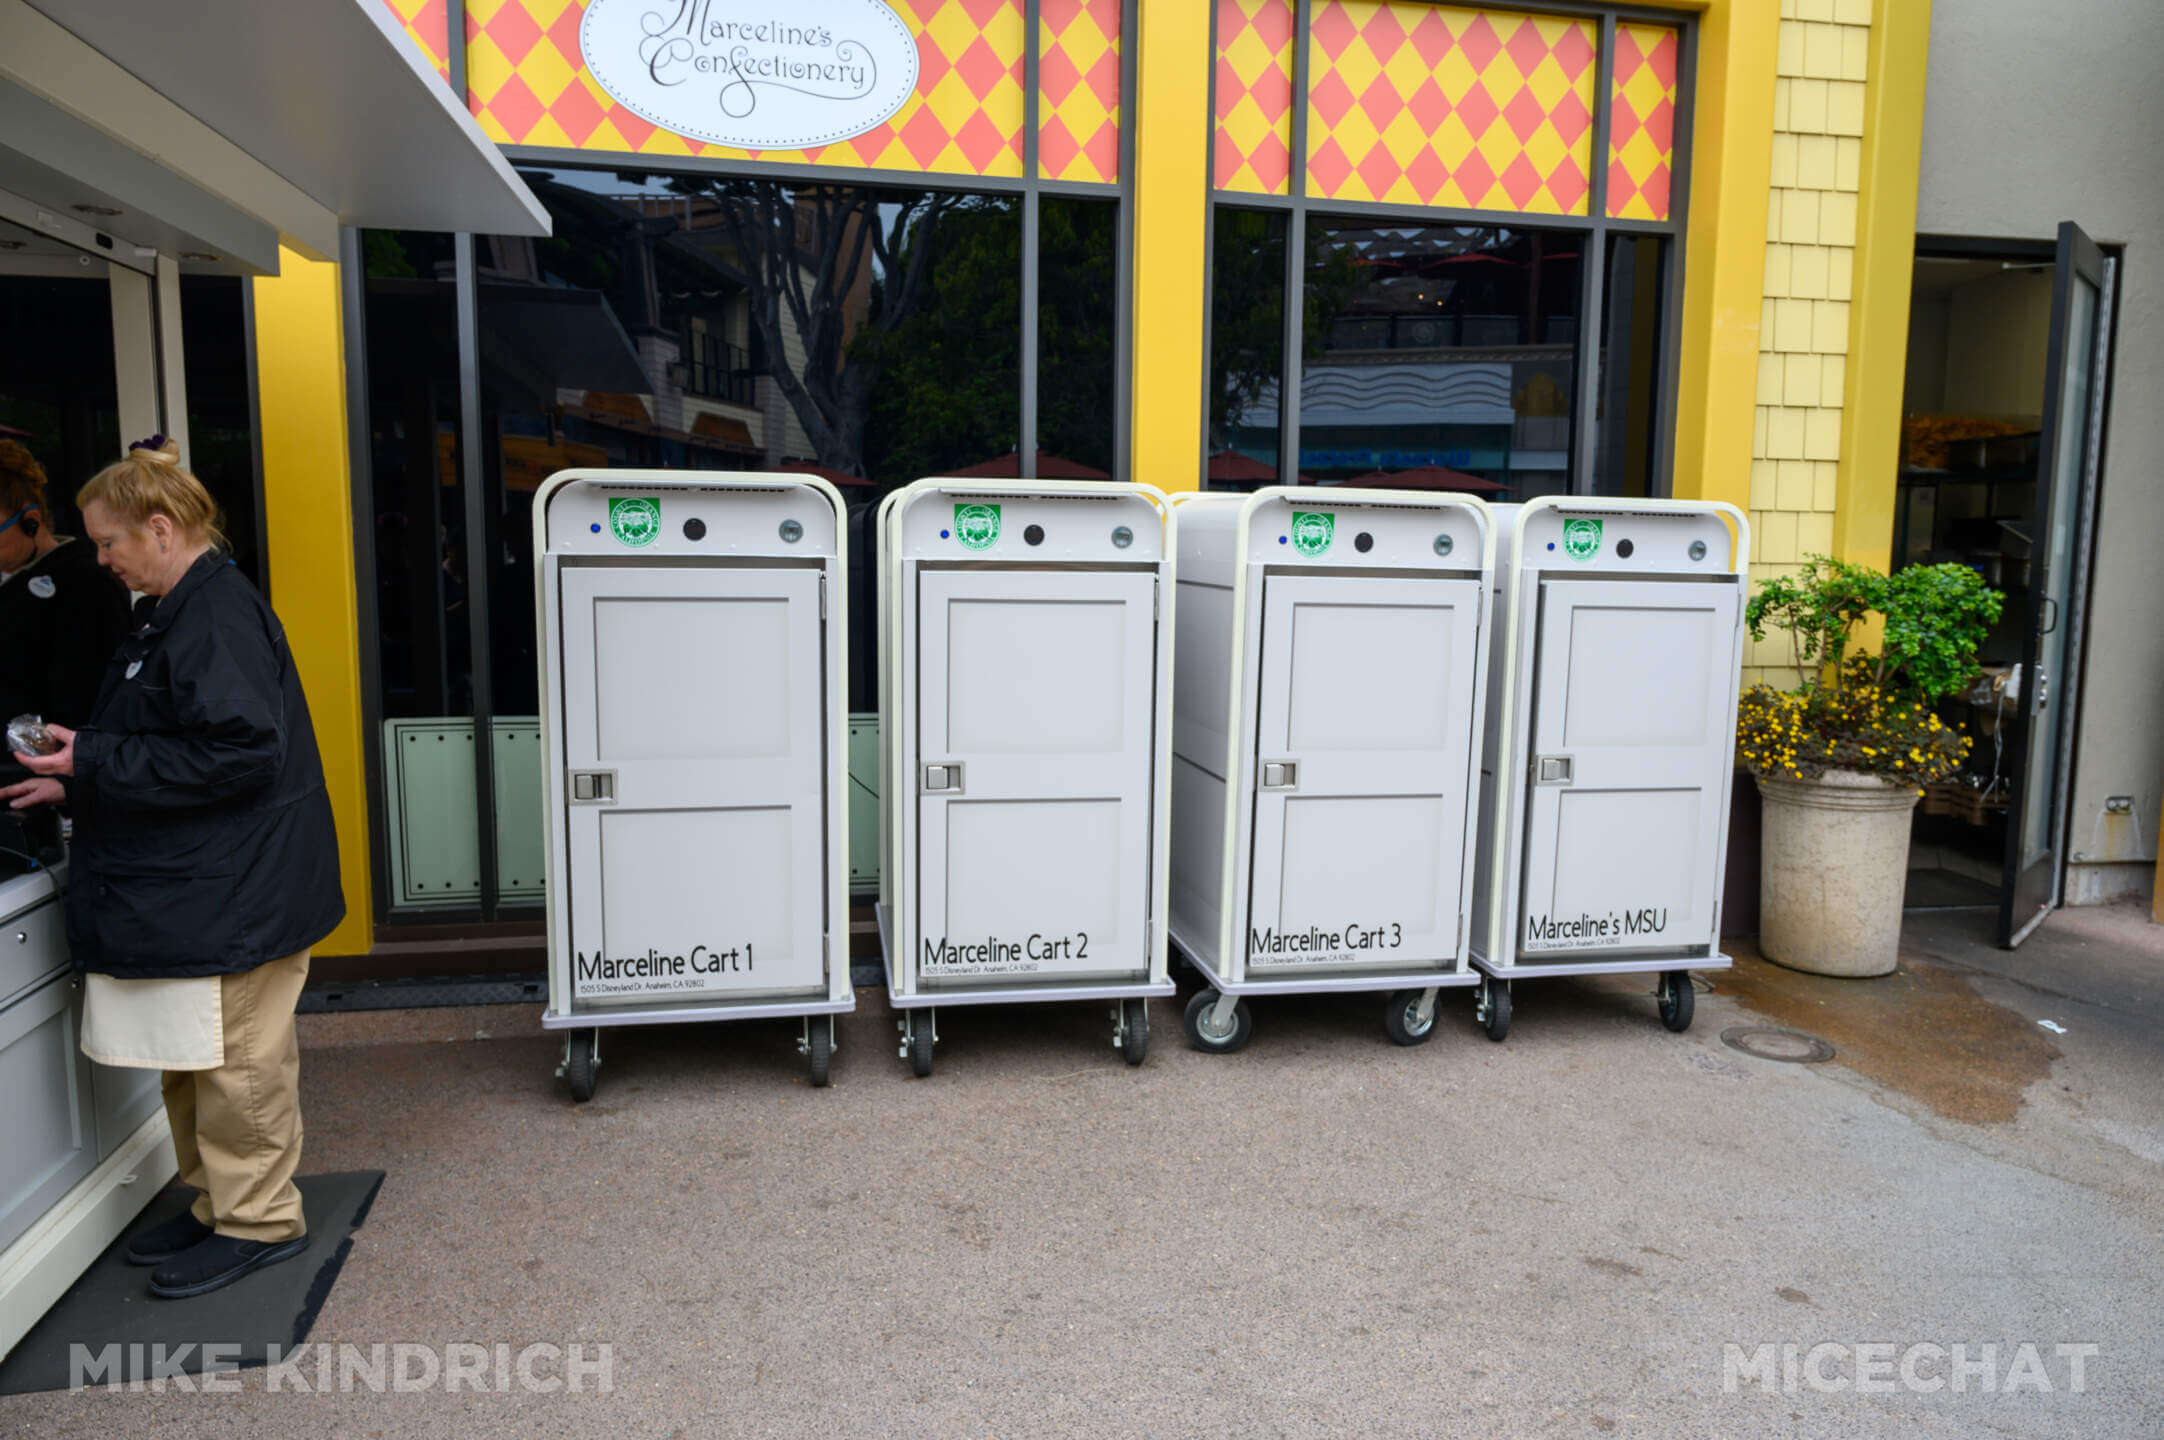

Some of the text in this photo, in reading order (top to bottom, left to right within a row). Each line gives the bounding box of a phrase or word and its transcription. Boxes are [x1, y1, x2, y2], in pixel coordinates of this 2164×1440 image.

[641, 0, 832, 46] Marceline's
[639, 36, 876, 118] Confectionery
[1252, 923, 1401, 954] Marceline Cart 3
[1529, 907, 1667, 940] Marceline's MSU
[578, 943, 753, 980] Marceline Cart 1
[924, 932, 1088, 965] Marceline Cart 2
[580, 984, 595, 993] 1505
[601, 983, 634, 993] Disneyland
[673, 980, 684, 988] CA
[684, 979, 705, 988] 92802
